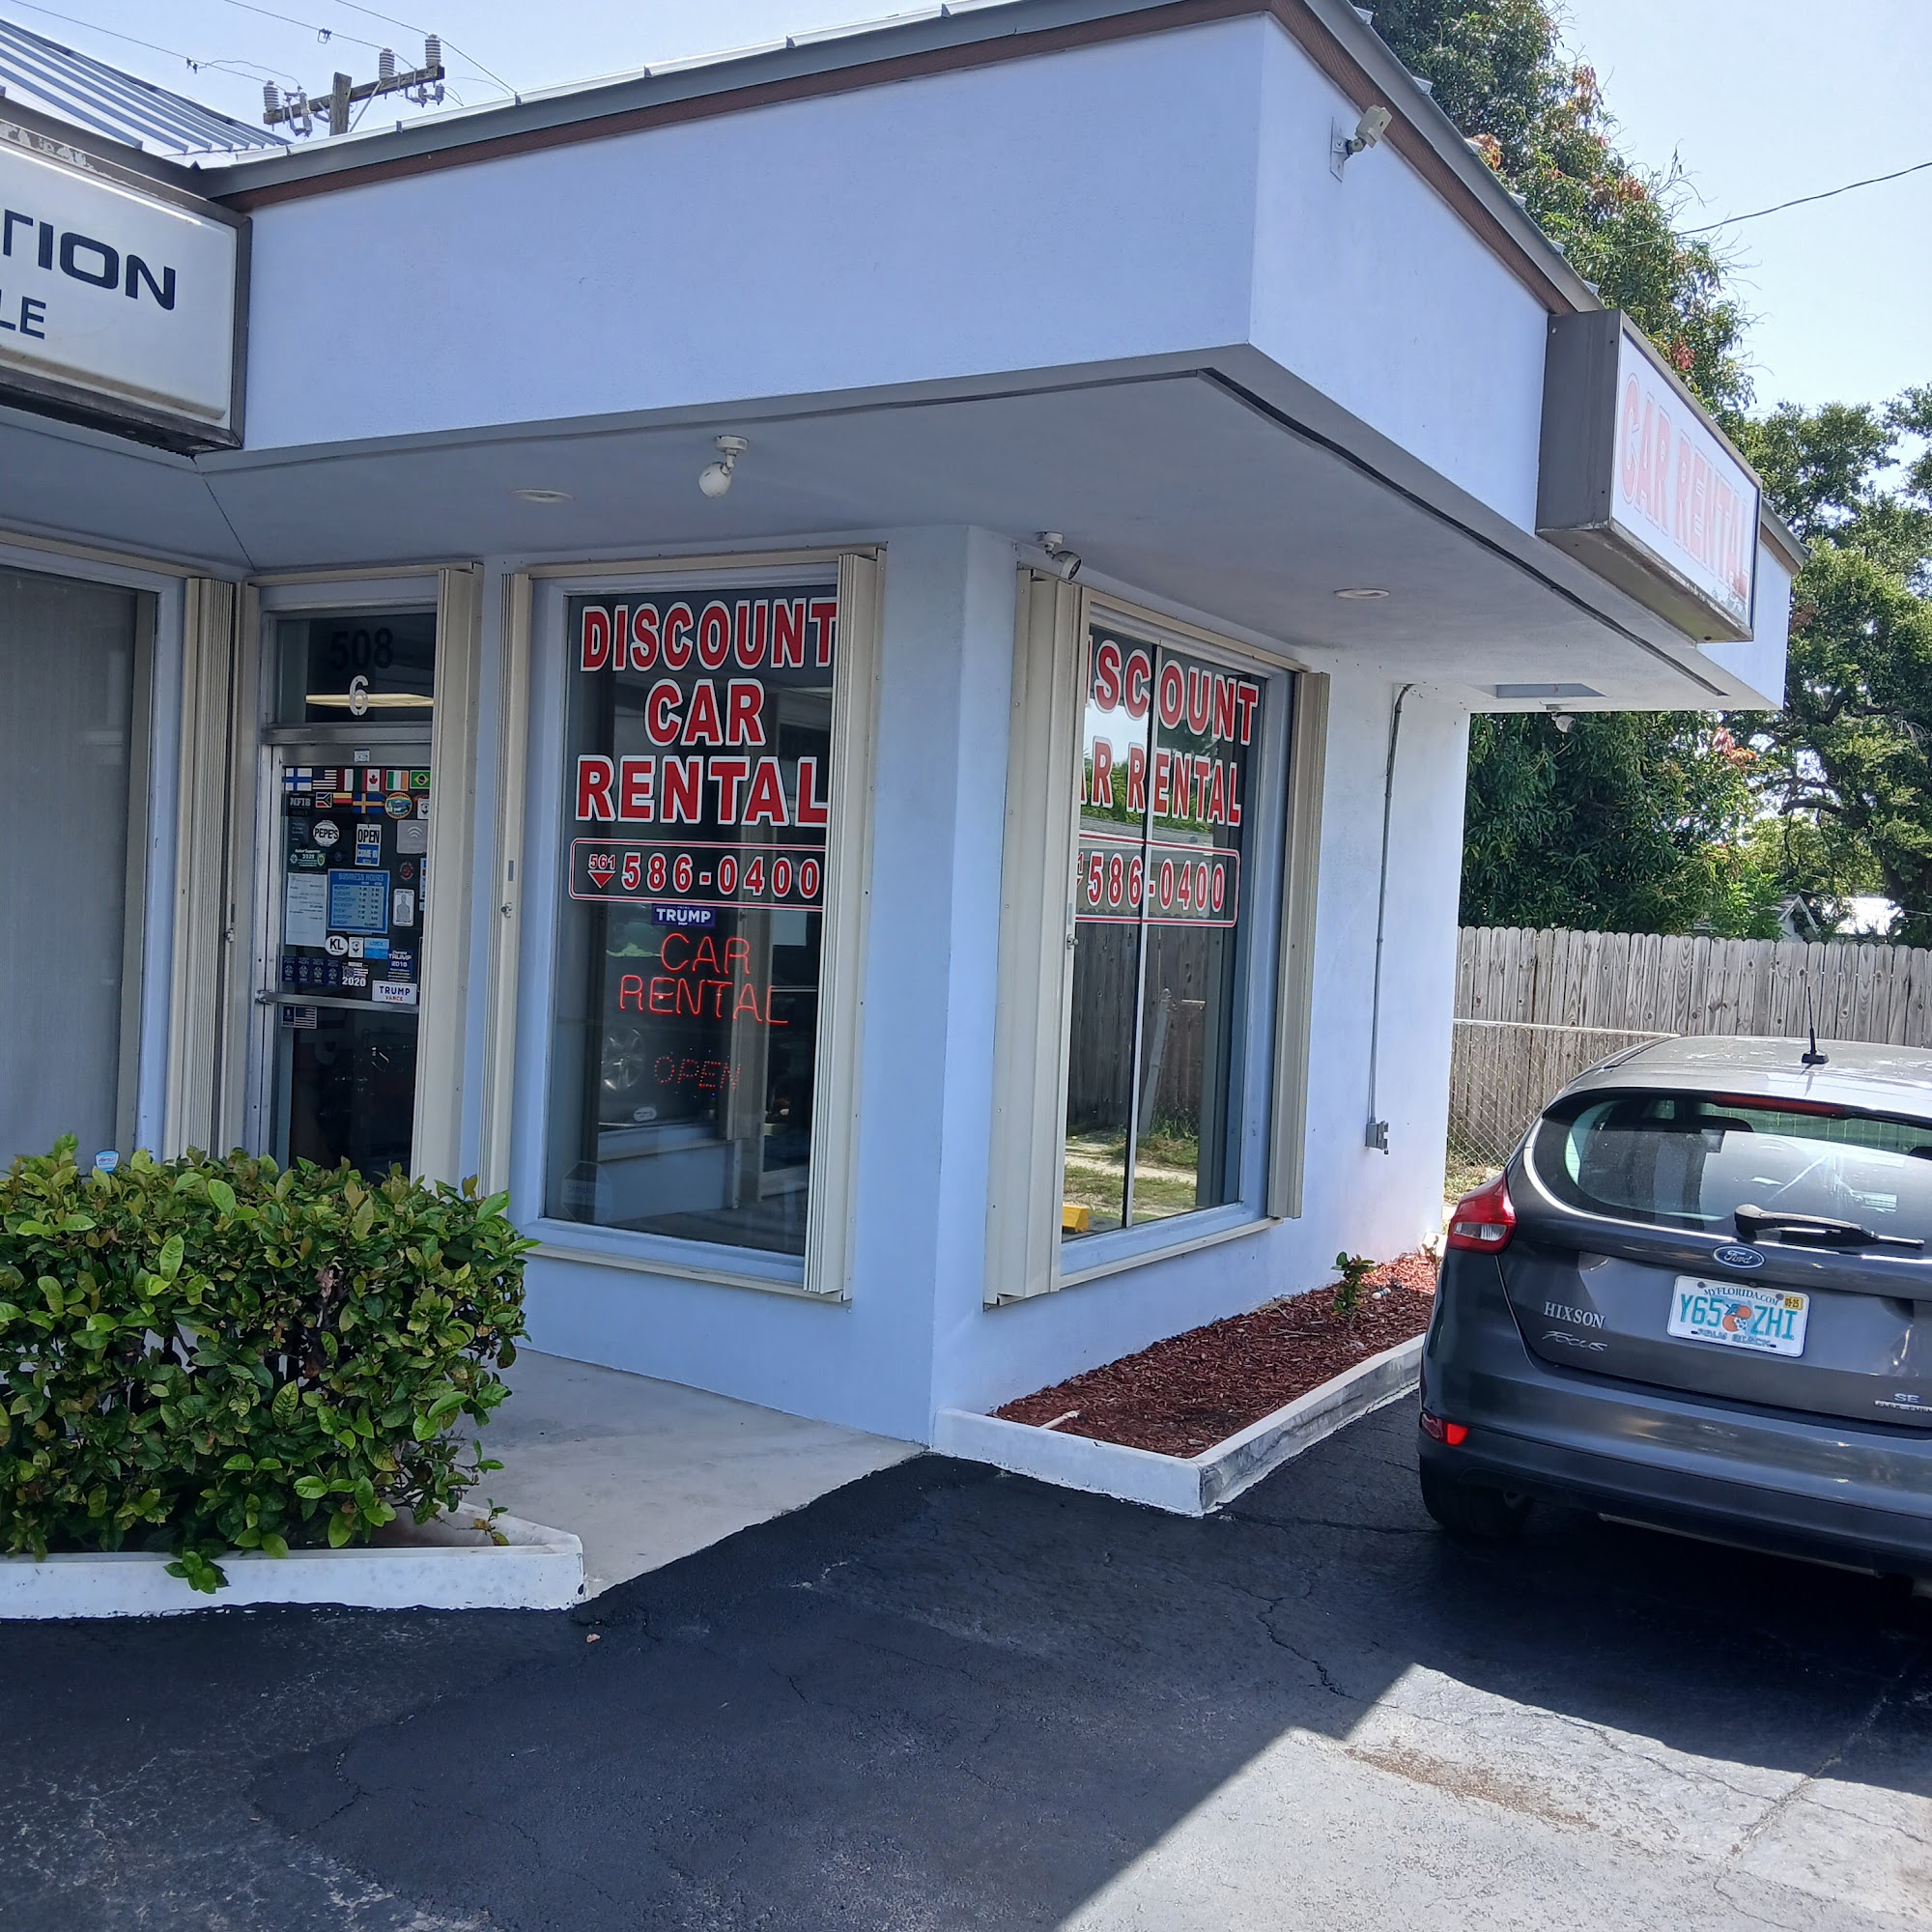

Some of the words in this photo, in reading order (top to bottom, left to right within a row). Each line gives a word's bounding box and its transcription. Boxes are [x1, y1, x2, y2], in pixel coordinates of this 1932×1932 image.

[3, 209, 176, 311] TION
[1622, 373, 1671, 536] CAR
[1674, 429, 1749, 601] RENTAL
[329, 627, 393, 669] 508
[581, 597, 838, 671] DISCOUNT
[349, 674, 369, 716] 6
[644, 678, 766, 747] CAR
[576, 754, 829, 827] RENTAL
[1126, 742, 1242, 827] RENTAL
[357, 829, 380, 843] OPEN
[588, 854, 616, 869] 561
[621, 851, 821, 899] 586-0400
[1086, 851, 1225, 912] 586-0400
[656, 908, 711, 923] TRUMP
[329, 938, 344, 951] KL
[661, 933, 751, 974] CAR
[342, 977, 367, 987] 2020
[379, 985, 411, 995] TRUMP
[619, 975, 788, 1024] RENTAL
[654, 1056, 742, 1090] OPEN
[1723, 1249, 1753, 1264] Ford
[1544, 1301, 1605, 1329] HIXSON
[1680, 1293, 1723, 1327] Y65
[1750, 1305, 1799, 1341] ZHI
[1703, 1287, 1780, 1306] MYFLORIDA.COM
[1894, 1393, 1919, 1404] SE
